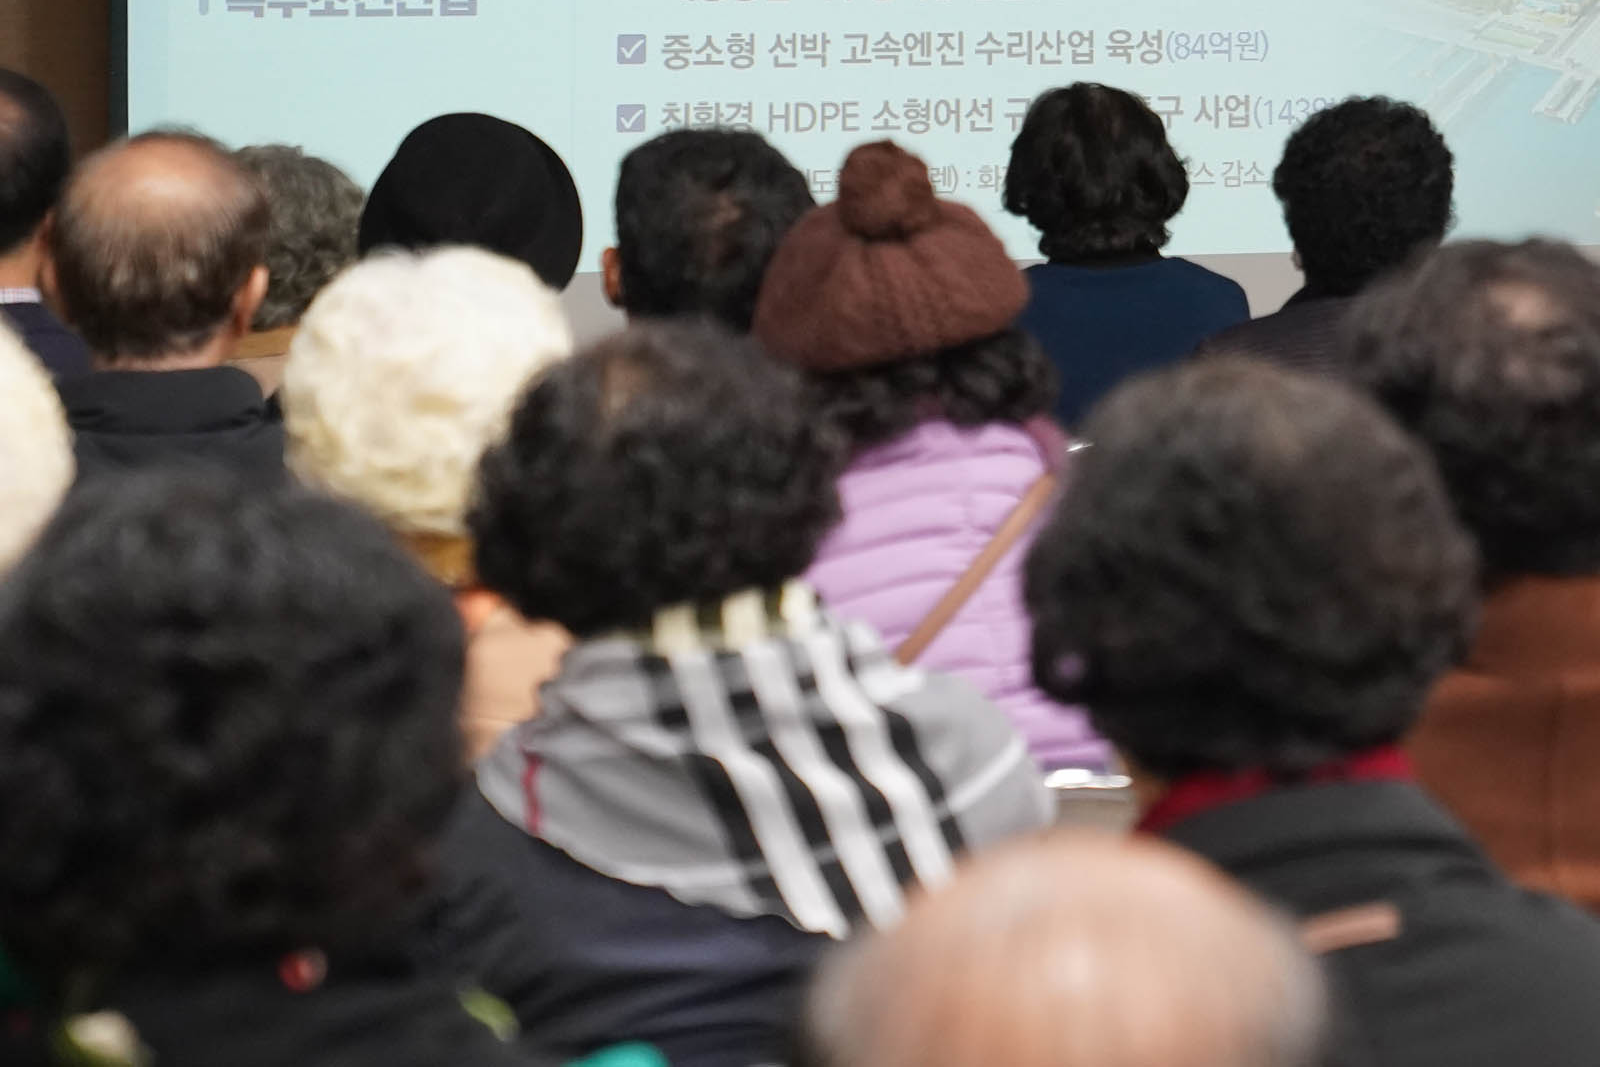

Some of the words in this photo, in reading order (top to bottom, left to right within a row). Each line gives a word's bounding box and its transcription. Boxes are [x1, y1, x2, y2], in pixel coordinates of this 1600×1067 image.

[661, 33, 755, 70] 중소형
[768, 31, 831, 68] 선박
[840, 31, 966, 67] 고속엔진
[974, 30, 1096, 66] 수리산업
[1105, 29, 1269, 66] 육성(84억원)
[660, 100, 753, 129] 친환경
[768, 101, 860, 133] HDPE
[870, 97, 994, 134] 소형어선
